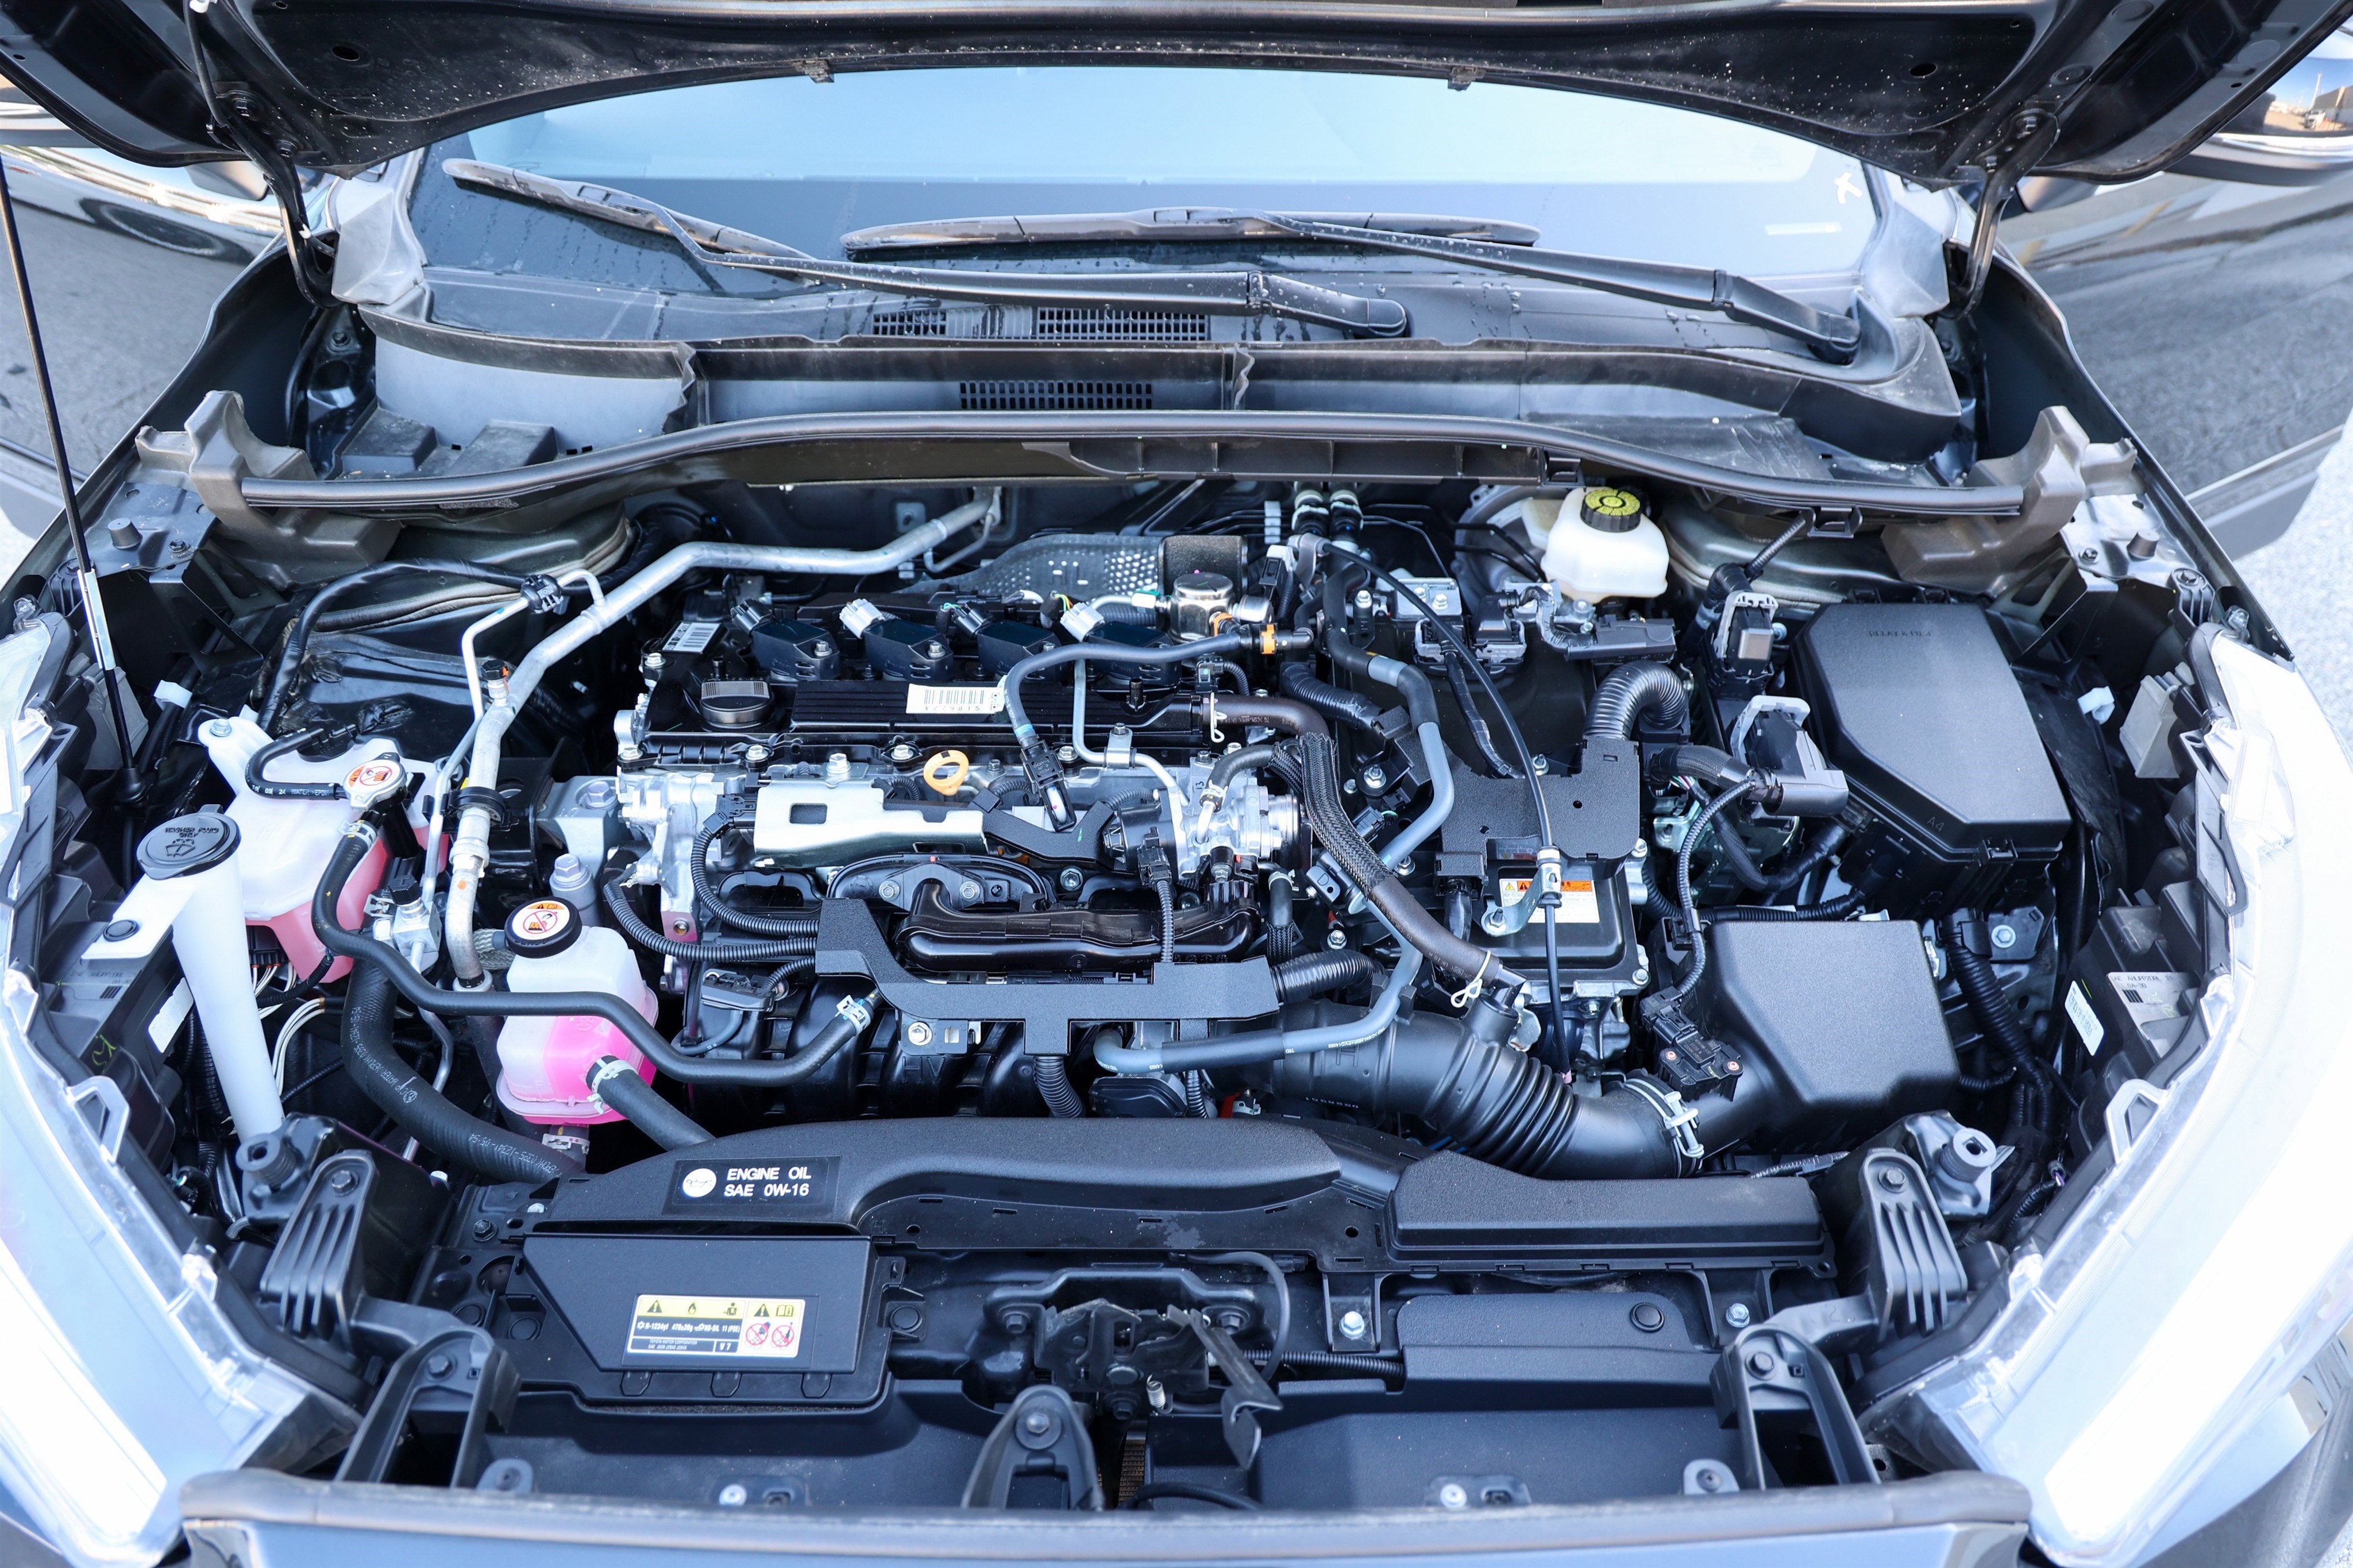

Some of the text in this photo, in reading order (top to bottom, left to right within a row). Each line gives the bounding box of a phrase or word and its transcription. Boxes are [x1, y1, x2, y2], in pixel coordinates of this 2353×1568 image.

[727, 1167, 812, 1180] ENGINE OIL
[724, 1183, 810, 1196] SAE 0W-16
[645, 1323, 669, 1331] R-1234yf
[720, 1342, 732, 1350] V 7
